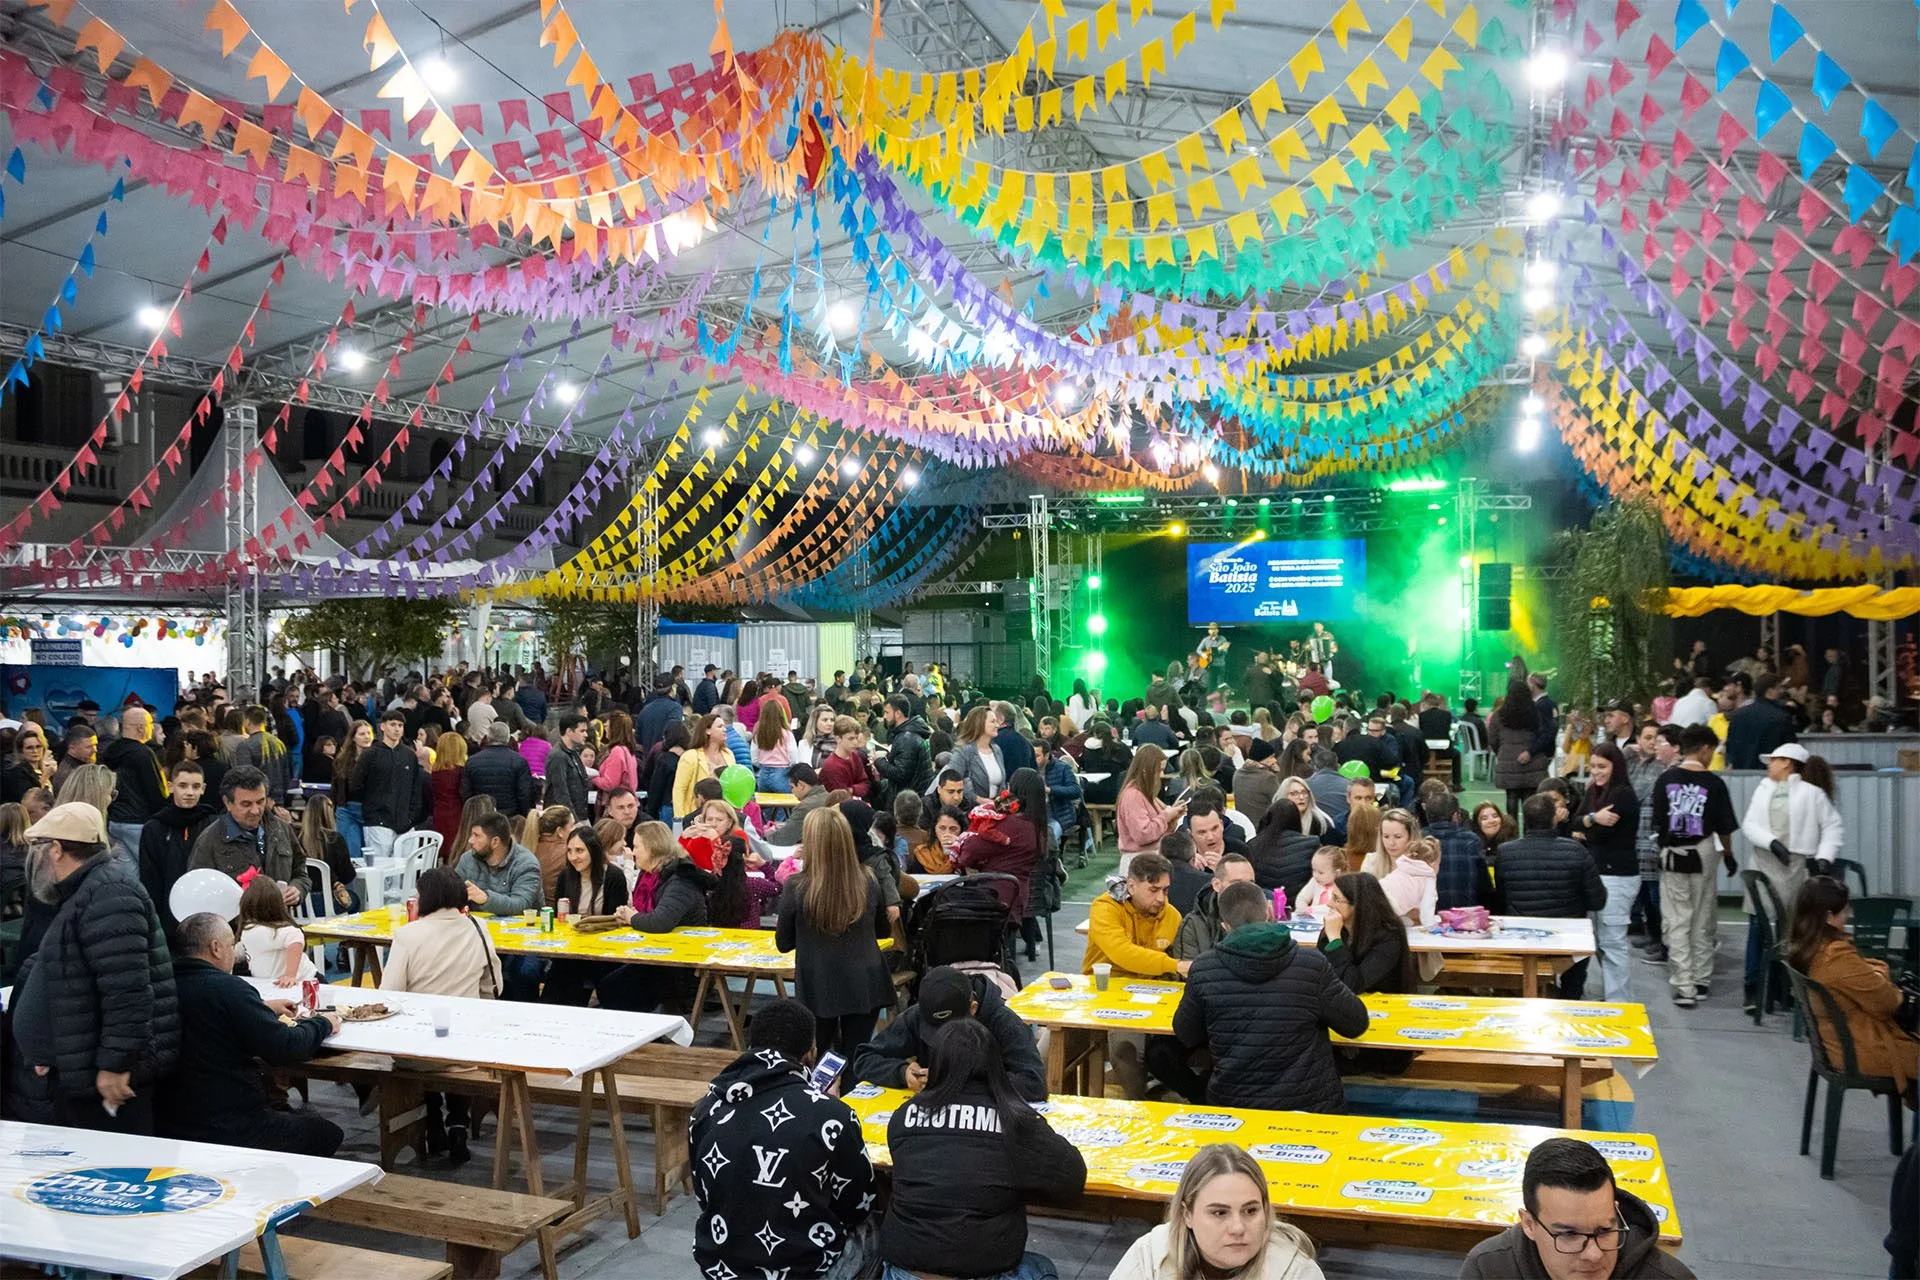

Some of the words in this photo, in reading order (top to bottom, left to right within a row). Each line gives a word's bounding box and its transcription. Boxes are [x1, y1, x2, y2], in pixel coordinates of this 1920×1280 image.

[1209, 562, 1230, 572] São
[1231, 561, 1257, 571] João
[1209, 571, 1257, 583] Batista
[1225, 583, 1256, 593] 2025
[1276, 1151, 1325, 1159] Brasil
[1599, 1148, 1647, 1156] Brasil
[1374, 1187, 1426, 1197] Brasil
